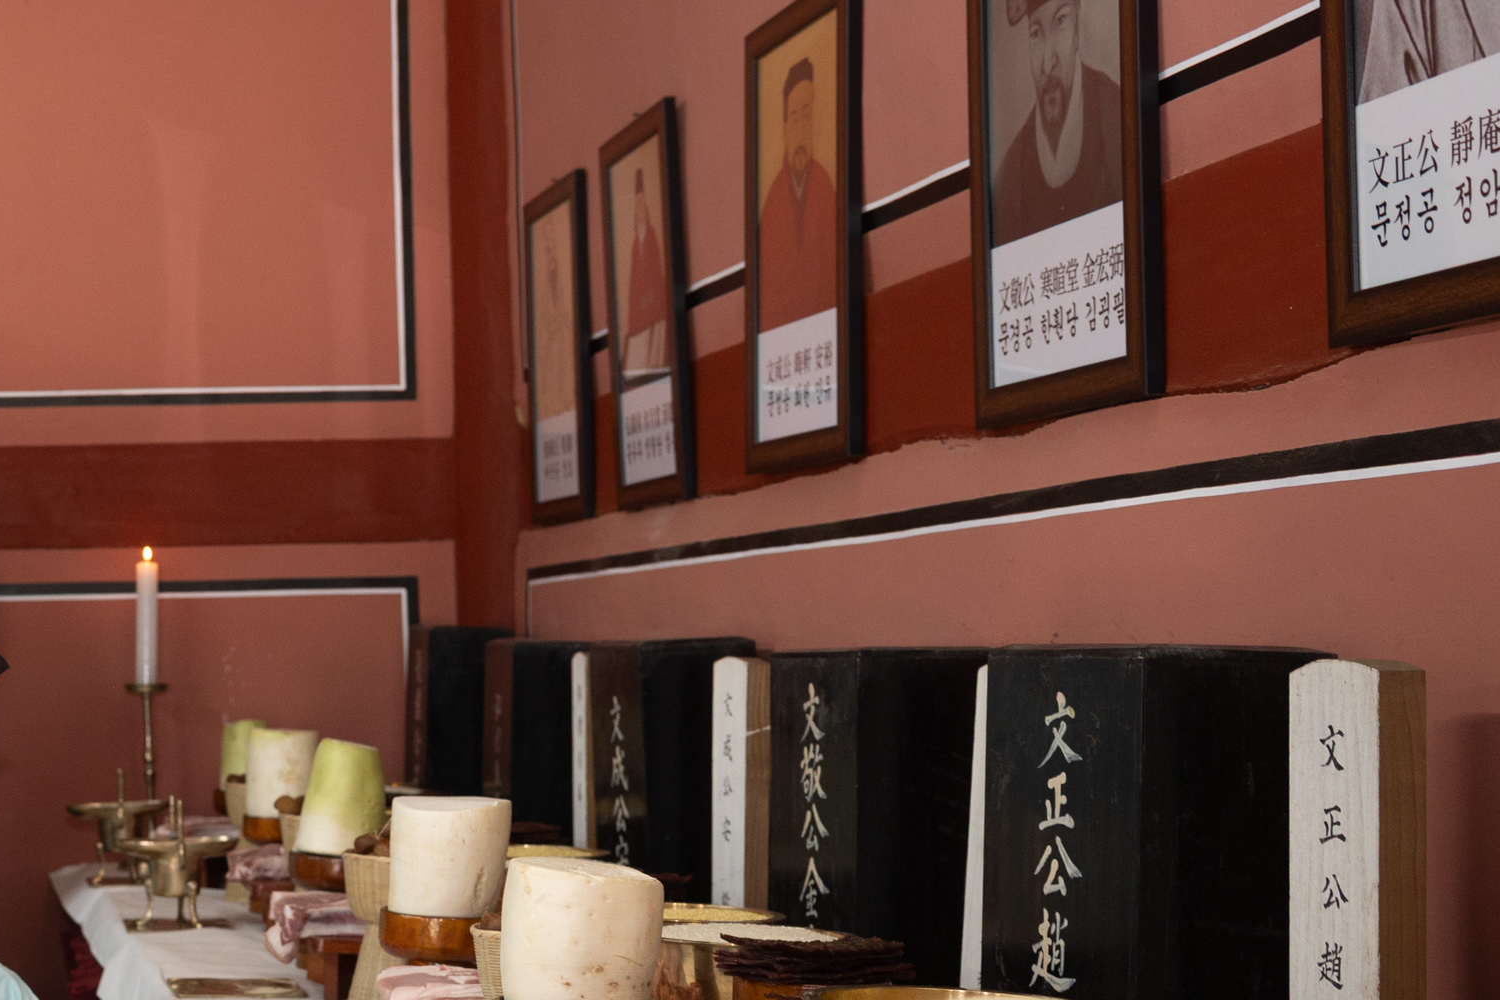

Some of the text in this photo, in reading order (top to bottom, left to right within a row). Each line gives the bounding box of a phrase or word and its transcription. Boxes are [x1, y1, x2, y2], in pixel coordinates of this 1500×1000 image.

[1367, 128, 1440, 194] 文正公
[1370, 187, 1439, 248] 문정공
[998, 272, 1036, 315] 文敬公
[998, 287, 1125, 356] 문경공 한훤당 김굉필
[799, 682, 830, 928] 文敬公金
[1029, 691, 1084, 994] 文正公趙
